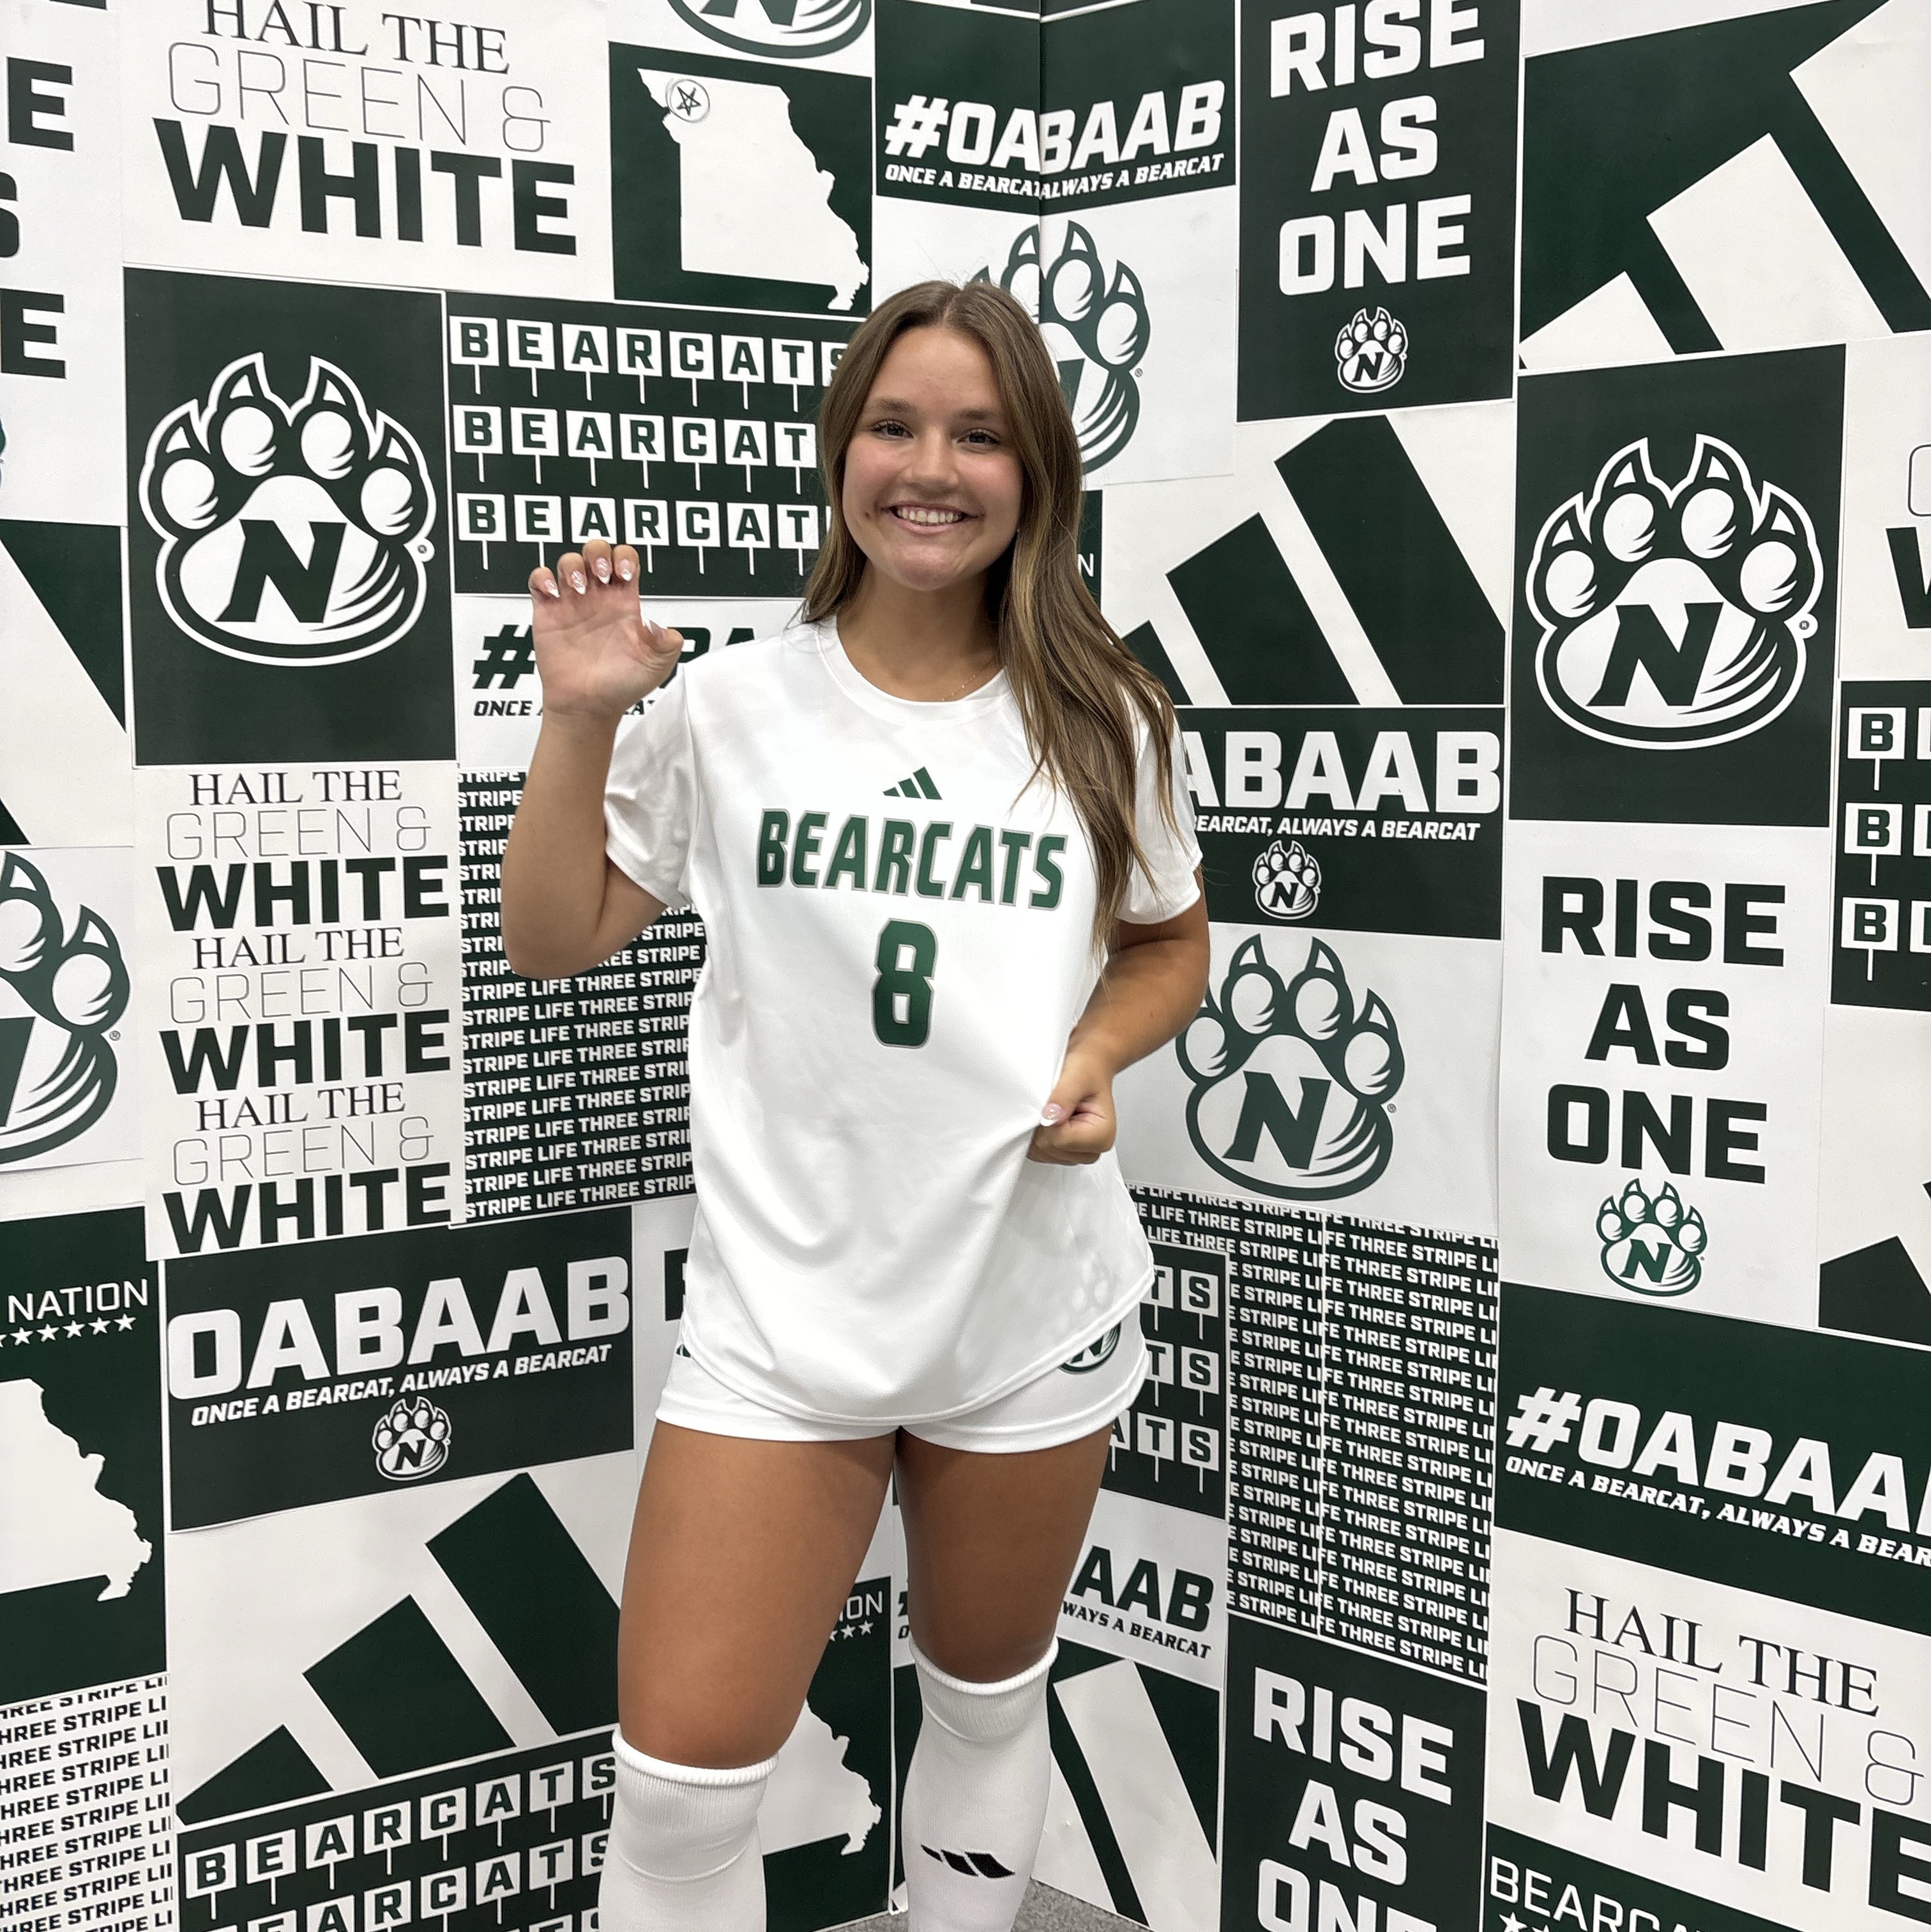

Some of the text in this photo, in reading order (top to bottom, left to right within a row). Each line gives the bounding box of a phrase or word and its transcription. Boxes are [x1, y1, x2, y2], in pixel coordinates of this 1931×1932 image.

[201, 0, 510, 75] HAIL THE
[1271, 0, 1485, 98] RISE
[169, 42, 467, 146] GREEN
[501, 85, 552, 153] &
[884, 79, 1225, 175] #OABAAB
[885, 164, 936, 186] ONCE
[939, 170, 954, 189] A
[1116, 167, 1130, 188] A
[1134, 153, 1224, 183] BEARCAT
[1311, 96, 1437, 192] AS
[152, 118, 576, 255] WHITE
[1280, 194, 1471, 295] ONE
[464, 418, 806, 476] BEARCAT
[467, 498, 810, 554] BEARCAT
[215, 519, 347, 624] N
[1586, 602, 1724, 706] N
[474, 701, 532, 716] ONCE
[189, 770, 402, 805] HAIL THE
[166, 805, 432, 860] GREEN &
[756, 807, 1069, 912] BEARCATS
[1277, 818, 1357, 837] ALWAYS
[1361, 820, 1377, 838] A
[1381, 820, 1480, 841] BEARCAT
[155, 855, 449, 931] WHITE
[1541, 876, 1785, 967] RISE
[192, 927, 404, 970] HAIL THE
[637, 945, 700, 965] STRIPE
[870, 917, 939, 1049] 8
[169, 961, 434, 1024] GREEN &
[531, 978, 572, 996] LIFE
[574, 973, 636, 993] THREE
[534, 1001, 575, 1019] LIFE
[578, 996, 639, 1015] THREE
[643, 991, 693, 1010] STRIP
[159, 1009, 450, 1095] WHITE
[530, 1025, 570, 1044] LIFE
[573, 1019, 634, 1040] THREE
[639, 1014, 689, 1033] STRIP
[533, 1048, 573, 1067] LIFE
[577, 1042, 637, 1063] THREE
[1584, 984, 1729, 1070] AS
[195, 1083, 405, 1131] HAIL THE
[531, 1096, 572, 1115] LIFE
[575, 1090, 635, 1110] THREE
[640, 1083, 690, 1103] STRIP
[536, 1072, 577, 1091] LIFE
[580, 1065, 640, 1086] THREE
[172, 1115, 435, 1186] GREEN &
[534, 1120, 575, 1138] LIFE
[578, 1113, 639, 1133] THREE
[538, 1143, 578, 1162] LIFE
[581, 1134, 641, 1156] THREE
[1222, 1070, 1332, 1170] N
[1547, 1084, 1767, 1184] ONE
[533, 1167, 573, 1186] LIFE
[577, 1159, 638, 1182] THREE
[641, 1152, 692, 1173] STRIP
[536, 1190, 577, 1210] LIFE
[579, 1183, 640, 1204] THREE
[644, 1174, 695, 1195] STRIP
[162, 1161, 451, 1254] WHITE
[1151, 1203, 1185, 1224] LIFE
[1188, 1209, 1240, 1232] THREE
[1244, 1218, 1303, 1242] STRIPE
[1349, 1233, 1407, 1259] THREE
[1412, 1244, 1477, 1270] STRIPE
[1481, 1256, 1497, 1274] LI
[8, 1279, 148, 1323] NATION
[167, 1255, 630, 1400] OABAAB
[1245, 1286, 1303, 1311] STRIPE
[1348, 1303, 1407, 1328] THREE
[1410, 1314, 1476, 1342] STRIPE
[1480, 1327, 1497, 1346] LI
[192, 1344, 612, 1426] ONCE A BEARCAT, ALWAYS A BEARCAT
[1506, 1386, 1931, 1535] #OABAA
[1506, 1456, 1565, 1482] ONCE
[1568, 1470, 1585, 1488] A
[1591, 1475, 1710, 1519] BEARCAT,
[1716, 1503, 1826, 1542] ALWAYS
[1829, 1529, 1849, 1549] A
[1242, 1549, 1299, 1581] STRIPE
[1342, 1576, 1399, 1607] THREE
[1403, 1594, 1468, 1626] STRIPE
[1472, 1613, 1488, 1632] LI
[1063, 1600, 1212, 1661] WAYS A BEARCAT
[1564, 1587, 1880, 1718] HAIL THE
[0, 1695, 167, 1746] HREE STRIPE LI
[1254, 1667, 1453, 1805] RISE
[1533, 1634, 1925, 1806] GREEN &
[0, 1767, 169, 1820] HREE STRIPE LI
[1515, 1696, 1931, 1926] WHITE
[0, 1839, 170, 1894] HREE STRIPE LI
[1289, 1779, 1407, 1885] AS
